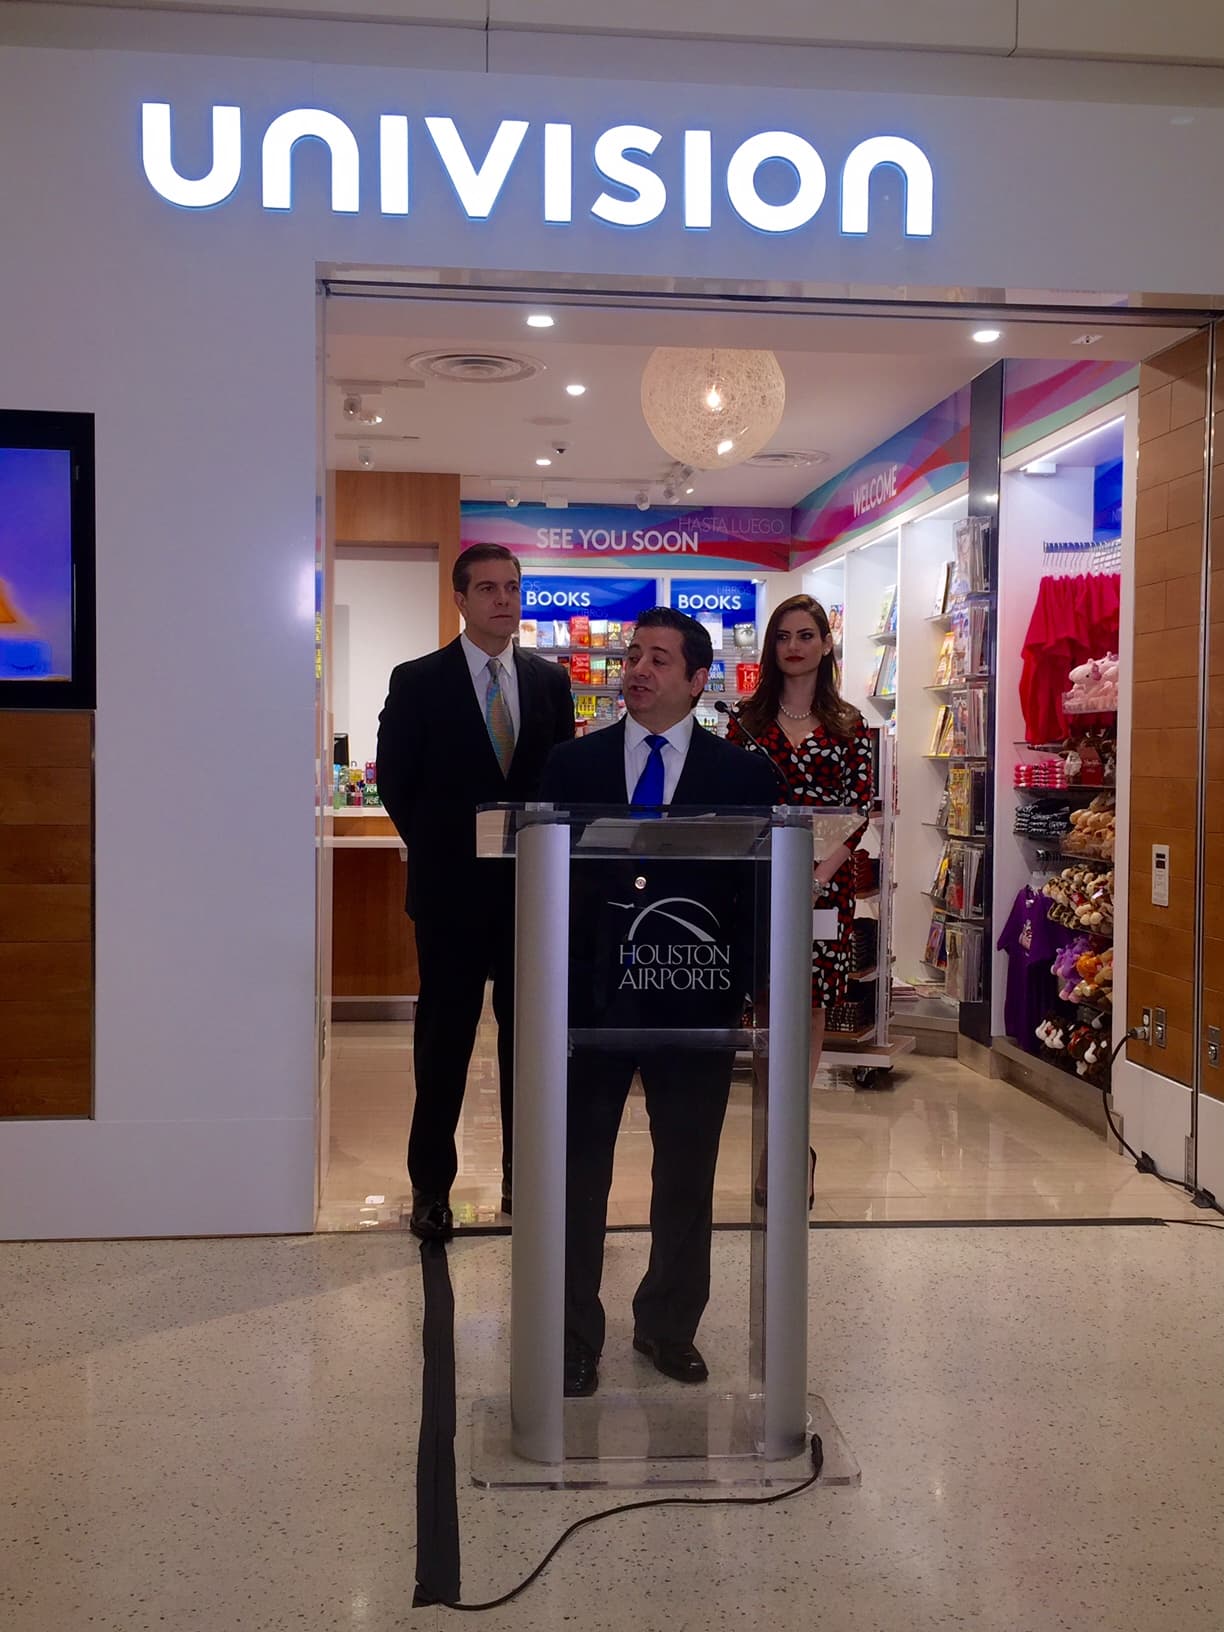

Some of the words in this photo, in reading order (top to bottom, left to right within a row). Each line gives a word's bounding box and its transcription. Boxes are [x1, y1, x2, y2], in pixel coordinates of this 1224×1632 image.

[141, 102, 935, 238] UNIVISION
[852, 464, 898, 519] WELCOME
[679, 516, 728, 533] HASTA
[732, 518, 785, 535] LUEGO
[536, 527, 574, 549] SEE
[578, 529, 627, 551] YOU
[631, 530, 699, 553] SOON
[526, 591, 591, 607] BOOKS
[678, 594, 742, 610] BOOKS
[619, 944, 731, 965] HOUSTON
[618, 968, 731, 990] AIRPORTS
